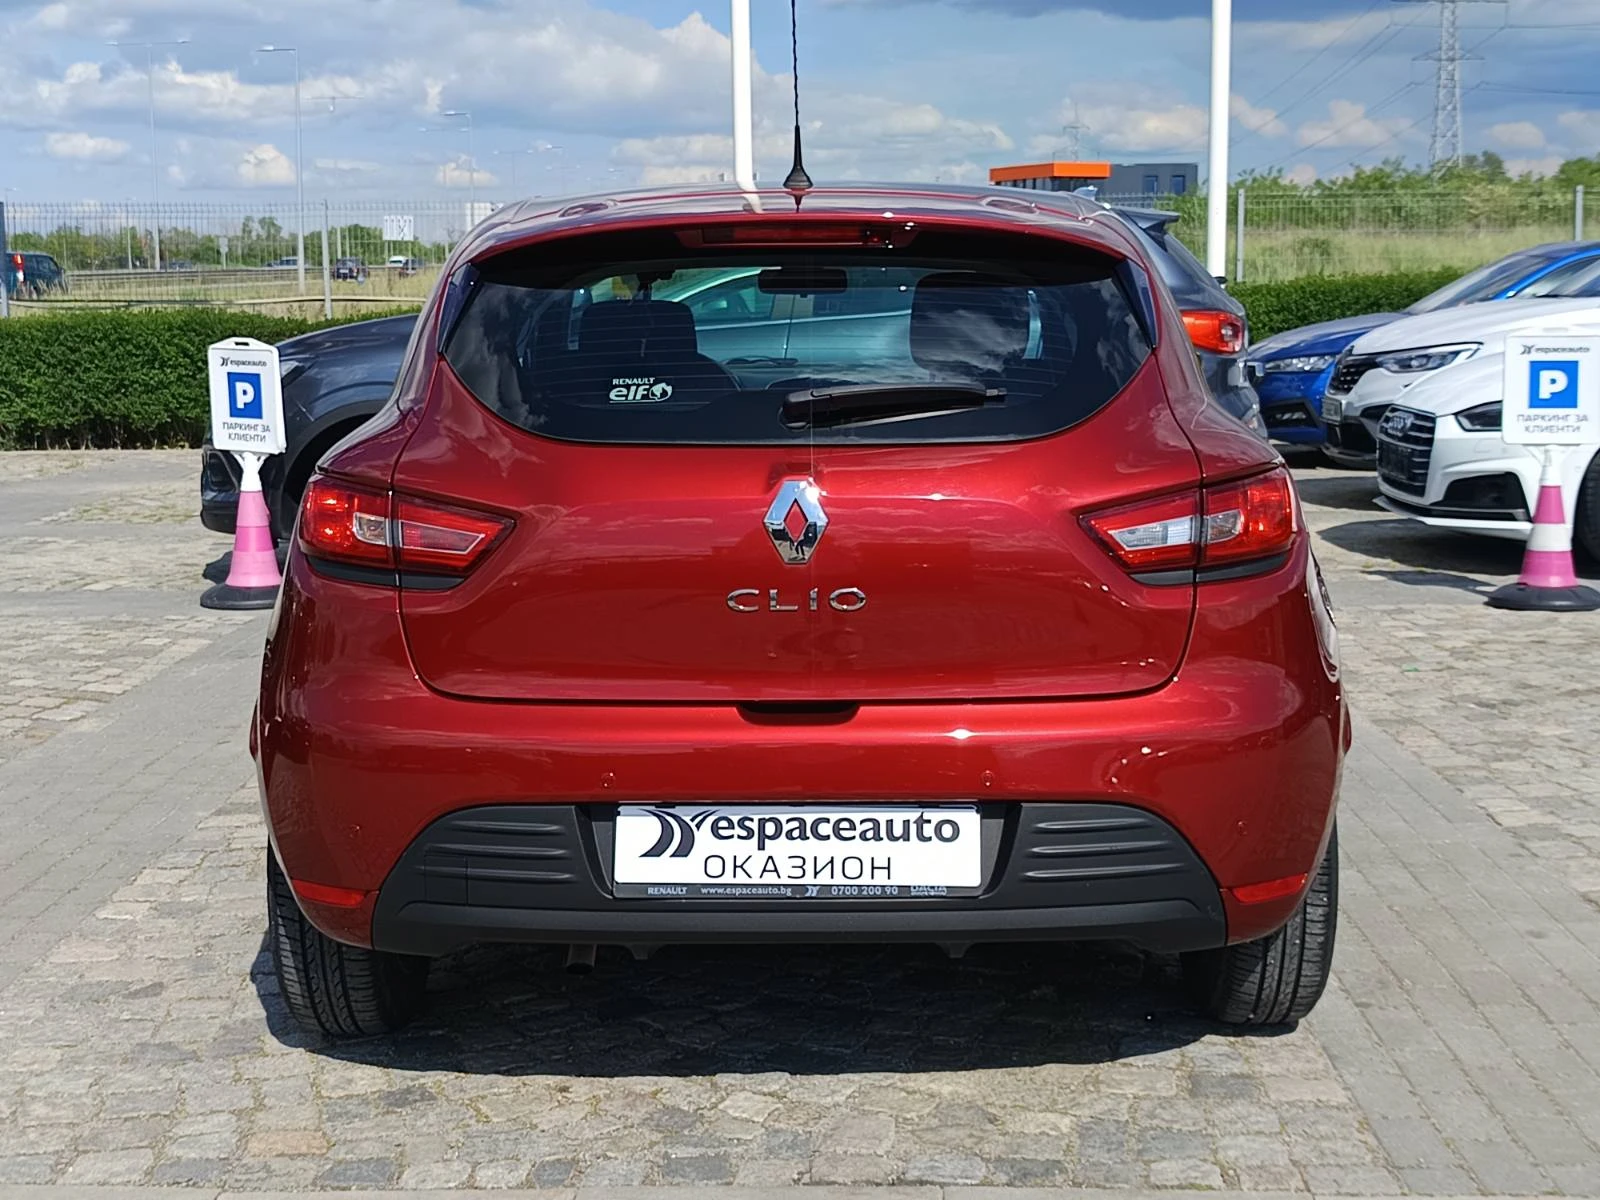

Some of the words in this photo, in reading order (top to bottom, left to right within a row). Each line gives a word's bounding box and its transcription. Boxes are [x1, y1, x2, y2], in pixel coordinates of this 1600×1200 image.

[1534, 346, 1590, 354] espaceauto
[230, 358, 267, 367] espaceauto
[612, 377, 655, 385] RENAULT
[1538, 369, 1568, 400] P
[235, 381, 255, 409] P
[1517, 414, 1571, 423] ПАРКИНГ
[1575, 414, 1589, 422] ЗА
[222, 422, 259, 432] ПАРКИНГ
[261, 424, 271, 433] ЗА
[1524, 424, 1581, 434] КЛИЕНТИ
[228, 432, 266, 443] КЛИЕНТИ
[727, 587, 867, 612] CLIO
[710, 811, 961, 851] espaceauto
[703, 854, 892, 881] ОКАЗИОН
[647, 886, 688, 896] RENAULT
[700, 886, 792, 897] www.espaceauto.bg
[831, 886, 858, 896] 0700
[861, 886, 882, 896] 200
[884, 886, 898, 895] 90
